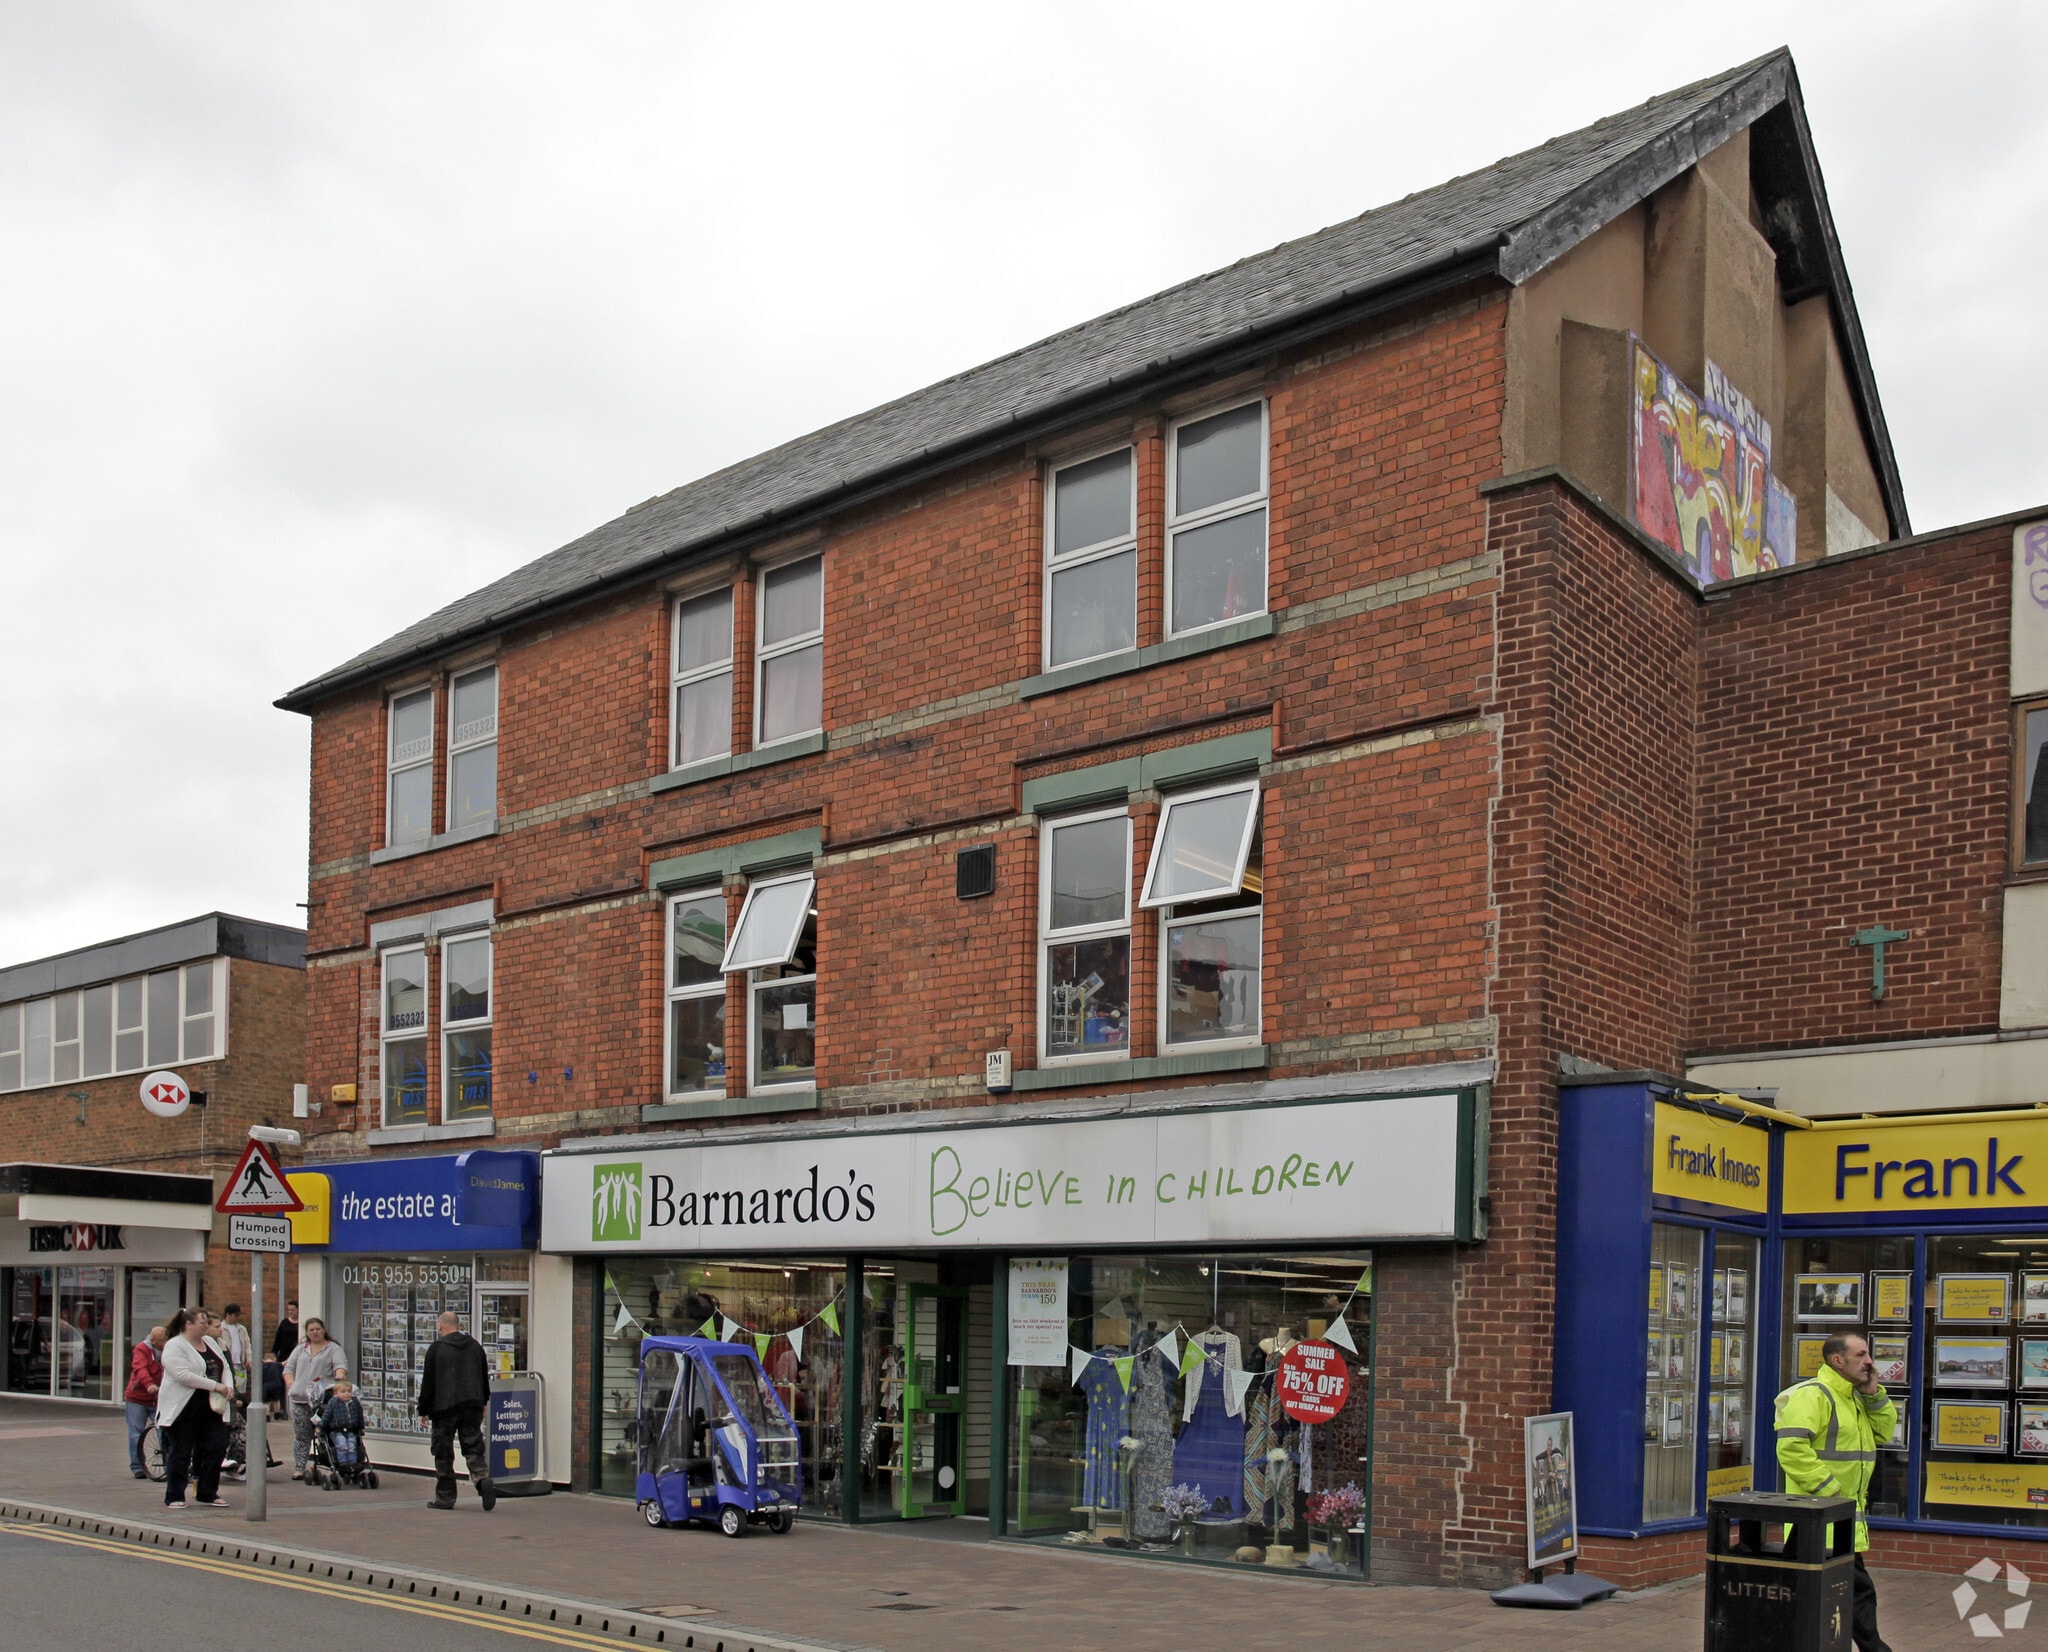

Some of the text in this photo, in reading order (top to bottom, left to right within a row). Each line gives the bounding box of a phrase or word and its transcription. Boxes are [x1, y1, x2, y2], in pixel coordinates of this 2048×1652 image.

[457, 717, 495, 741] 9552323
[397, 738, 431, 761] 9552323
[988, 1054, 1002, 1067] JM
[1669, 1134, 1761, 1188] Frank Innes
[1835, 1137, 2026, 1200] Frank
[1156, 1153, 1355, 1204] CHILDREN
[648, 1164, 876, 1228] Barnardo's
[341, 1190, 371, 1221] the
[375, 1192, 435, 1219] estate
[235, 1220, 287, 1235] Humped
[29, 1225, 126, 1252] HSBC UK
[234, 1236, 286, 1250] crossing
[343, 1264, 460, 1285] 0115 955 5550
[1040, 1294, 1057, 1305] 150
[1297, 1344, 1335, 1360] SUMMER
[1305, 1357, 1326, 1371] SALE
[1882, 1360, 1905, 1380] SOLD
[1283, 1370, 1345, 1396] 75% OFF
[1286, 1400, 1298, 1408] GIFT
[1299, 1402, 1314, 1411] WRAP
[1319, 1405, 1335, 1414] BAGS
[1302, 1395, 1320, 1404] CARDS
[496, 1411, 523, 1420] Lettings
[498, 1422, 527, 1432] Property
[491, 1432, 534, 1443] Management
[1939, 1472, 1965, 1481] Thanks
[1980, 1475, 1992, 1483] the
[1995, 1475, 2021, 1486] support
[1940, 1486, 1958, 1495] every
[1961, 1484, 1975, 1493] step
[1728, 1581, 1792, 1601] LITTER
